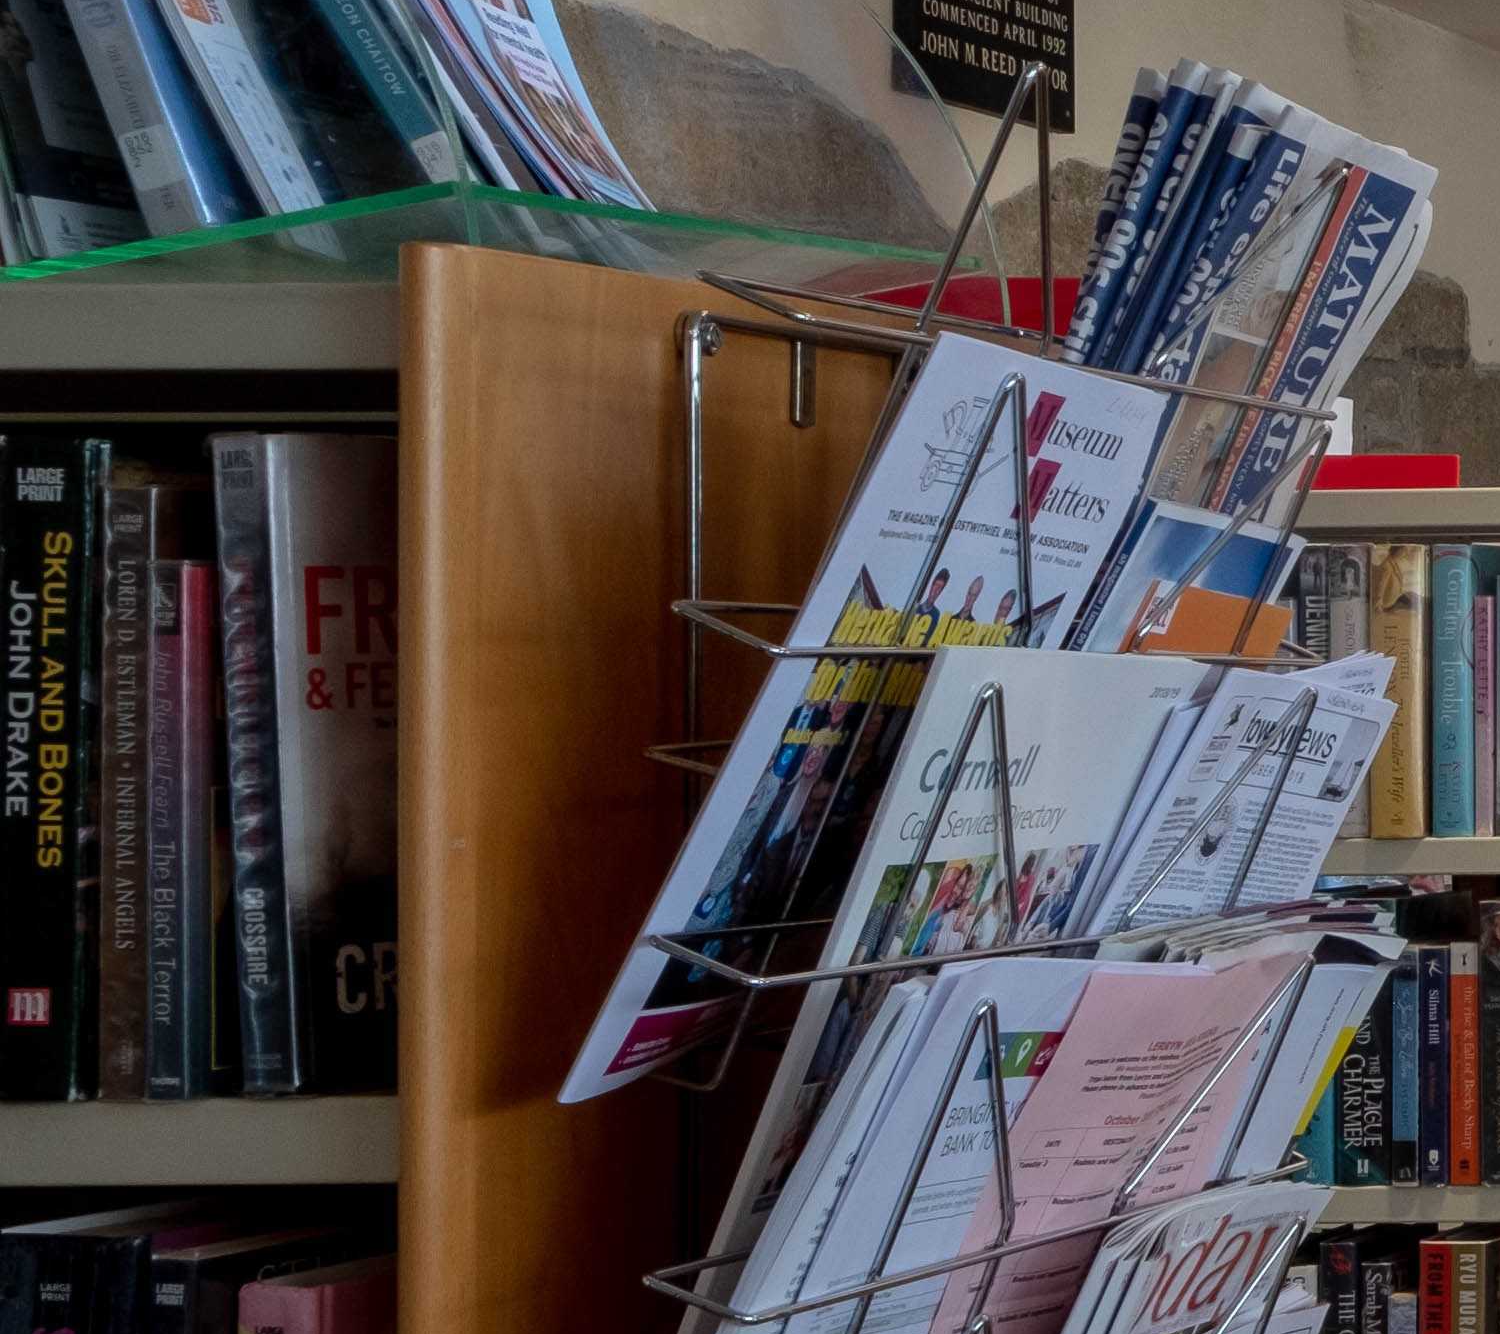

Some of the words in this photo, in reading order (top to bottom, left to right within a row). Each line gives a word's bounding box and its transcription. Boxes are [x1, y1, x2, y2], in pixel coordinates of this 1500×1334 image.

[920, 30, 960, 61] JOHN
[1003, 23, 1038, 49] APRIL
[1043, 34, 1067, 57] 1992
[1015, 0, 1068, 34] BUILDING
[351, 23, 405, 96] CHAITOW
[1249, 149, 1299, 224] Life
[1254, 203, 1397, 476] MATURE
[16, 467, 65, 485] LARGE
[16, 484, 65, 503] PRINT
[43, 530, 75, 656] SKULL
[117, 558, 139, 626] LOREN
[7, 579, 39, 681] JOHN
[38, 663, 66, 732] AND
[116, 654, 139, 756] ESTLEMAN
[3, 690, 36, 818] DRAKE
[37, 741, 69, 870] BONES
[113, 775, 136, 871] INFERNAL
[151, 841, 175, 876] The
[112, 872, 136, 953] ANGELS
[151, 878, 175, 950] Black
[241, 883, 270, 987] CROSSFIRE
[151, 953, 174, 1028] Terror
[1343, 1053, 1366, 1150] CHARMER
[1363, 1077, 1386, 1148] PLAGUE
[1457, 1252, 1479, 1286] RYU
